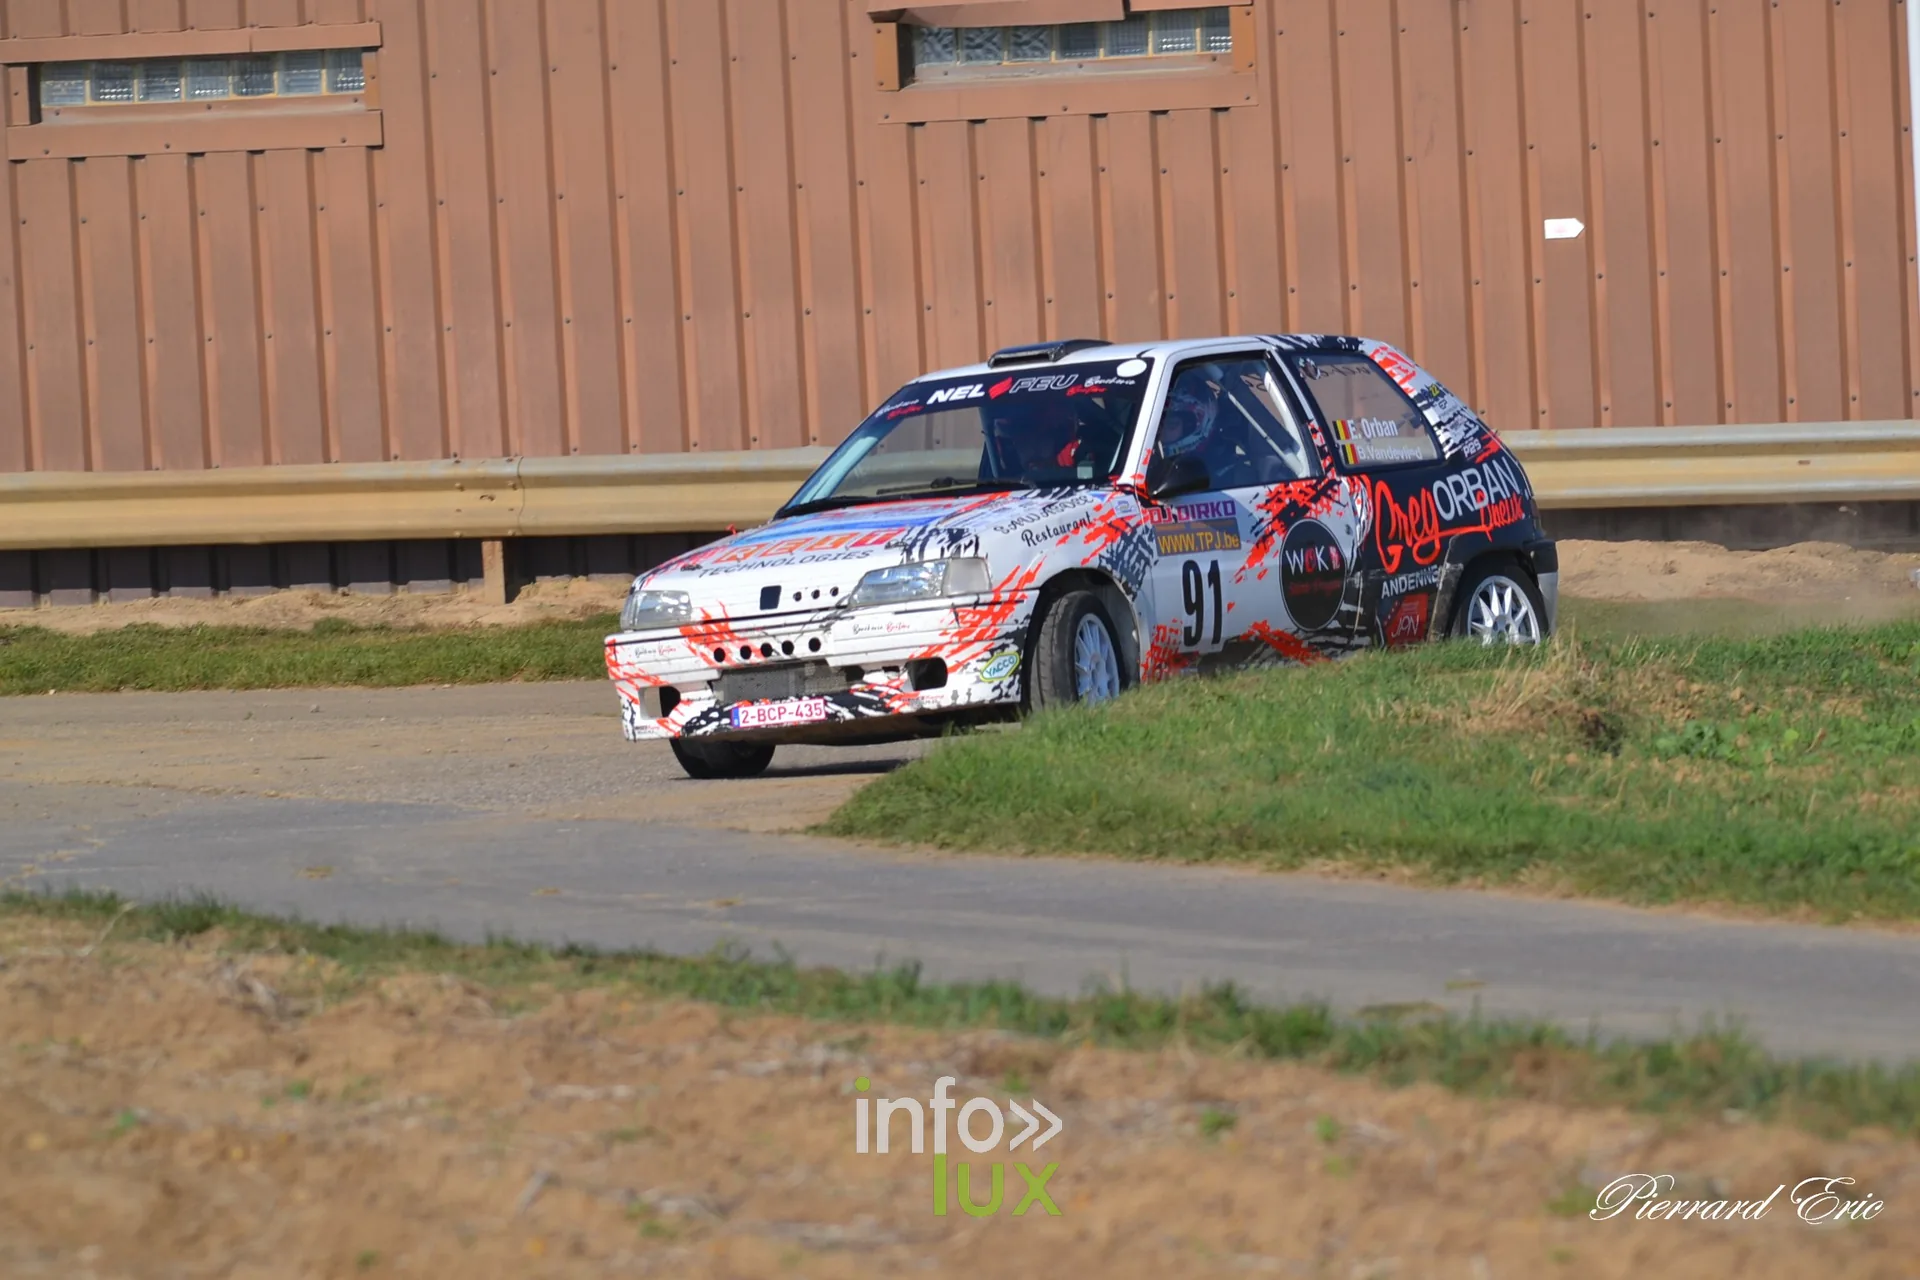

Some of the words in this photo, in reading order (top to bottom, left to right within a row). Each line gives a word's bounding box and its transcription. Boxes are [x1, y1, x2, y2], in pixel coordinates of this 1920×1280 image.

[927, 383, 986, 405] NEL
[1009, 374, 1079, 394] FEU
[1347, 420, 1361, 440] E.
[1361, 417, 1399, 439] Orban
[1433, 456, 1520, 521] ORBAN
[1177, 500, 1236, 522] DIRKO
[1021, 511, 1092, 547] Restaurant
[1157, 530, 1240, 555] WWW.TPJ.be
[699, 549, 874, 578] TECHNOLOGIES
[1182, 559, 1222, 648] 91
[986, 655, 1015, 677] YACCO
[741, 702, 823, 724] 2-BCP-435
